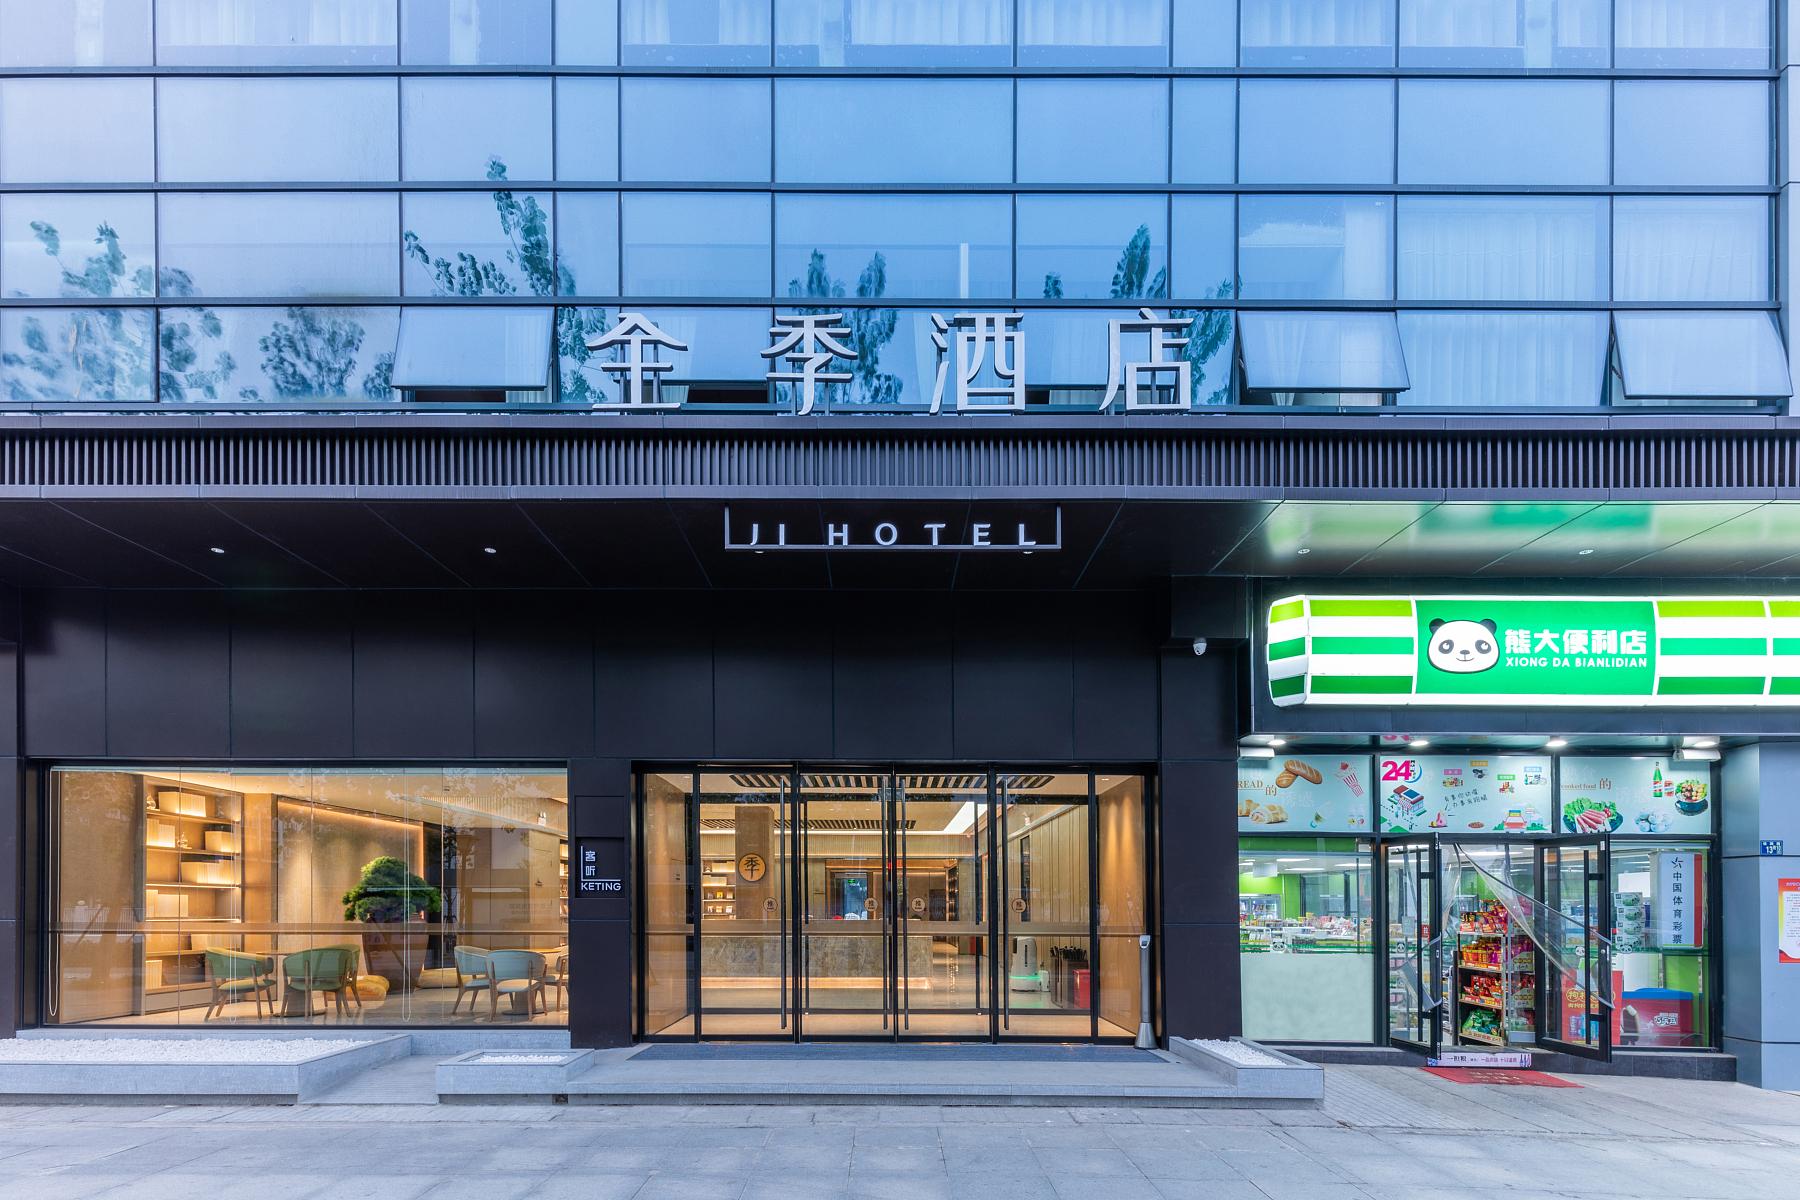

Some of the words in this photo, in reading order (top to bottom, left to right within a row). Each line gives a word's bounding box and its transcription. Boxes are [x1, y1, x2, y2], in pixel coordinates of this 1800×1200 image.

[585, 308, 1193, 416] 全季酒店
[750, 523, 785, 546] JI
[828, 523, 1037, 546] HOTEL
[1504, 629, 1647, 654] 熊大便利店
[1506, 657, 1548, 667] XIONG
[1552, 657, 1571, 668] DA
[1574, 657, 1647, 668] BIANLIDIAN
[1382, 760, 1412, 781] 24
[1237, 779, 1264, 789] READ
[744, 857, 760, 879] 季
[581, 882, 622, 891] KETING
[1672, 871, 1683, 944] 中国体育彩票
